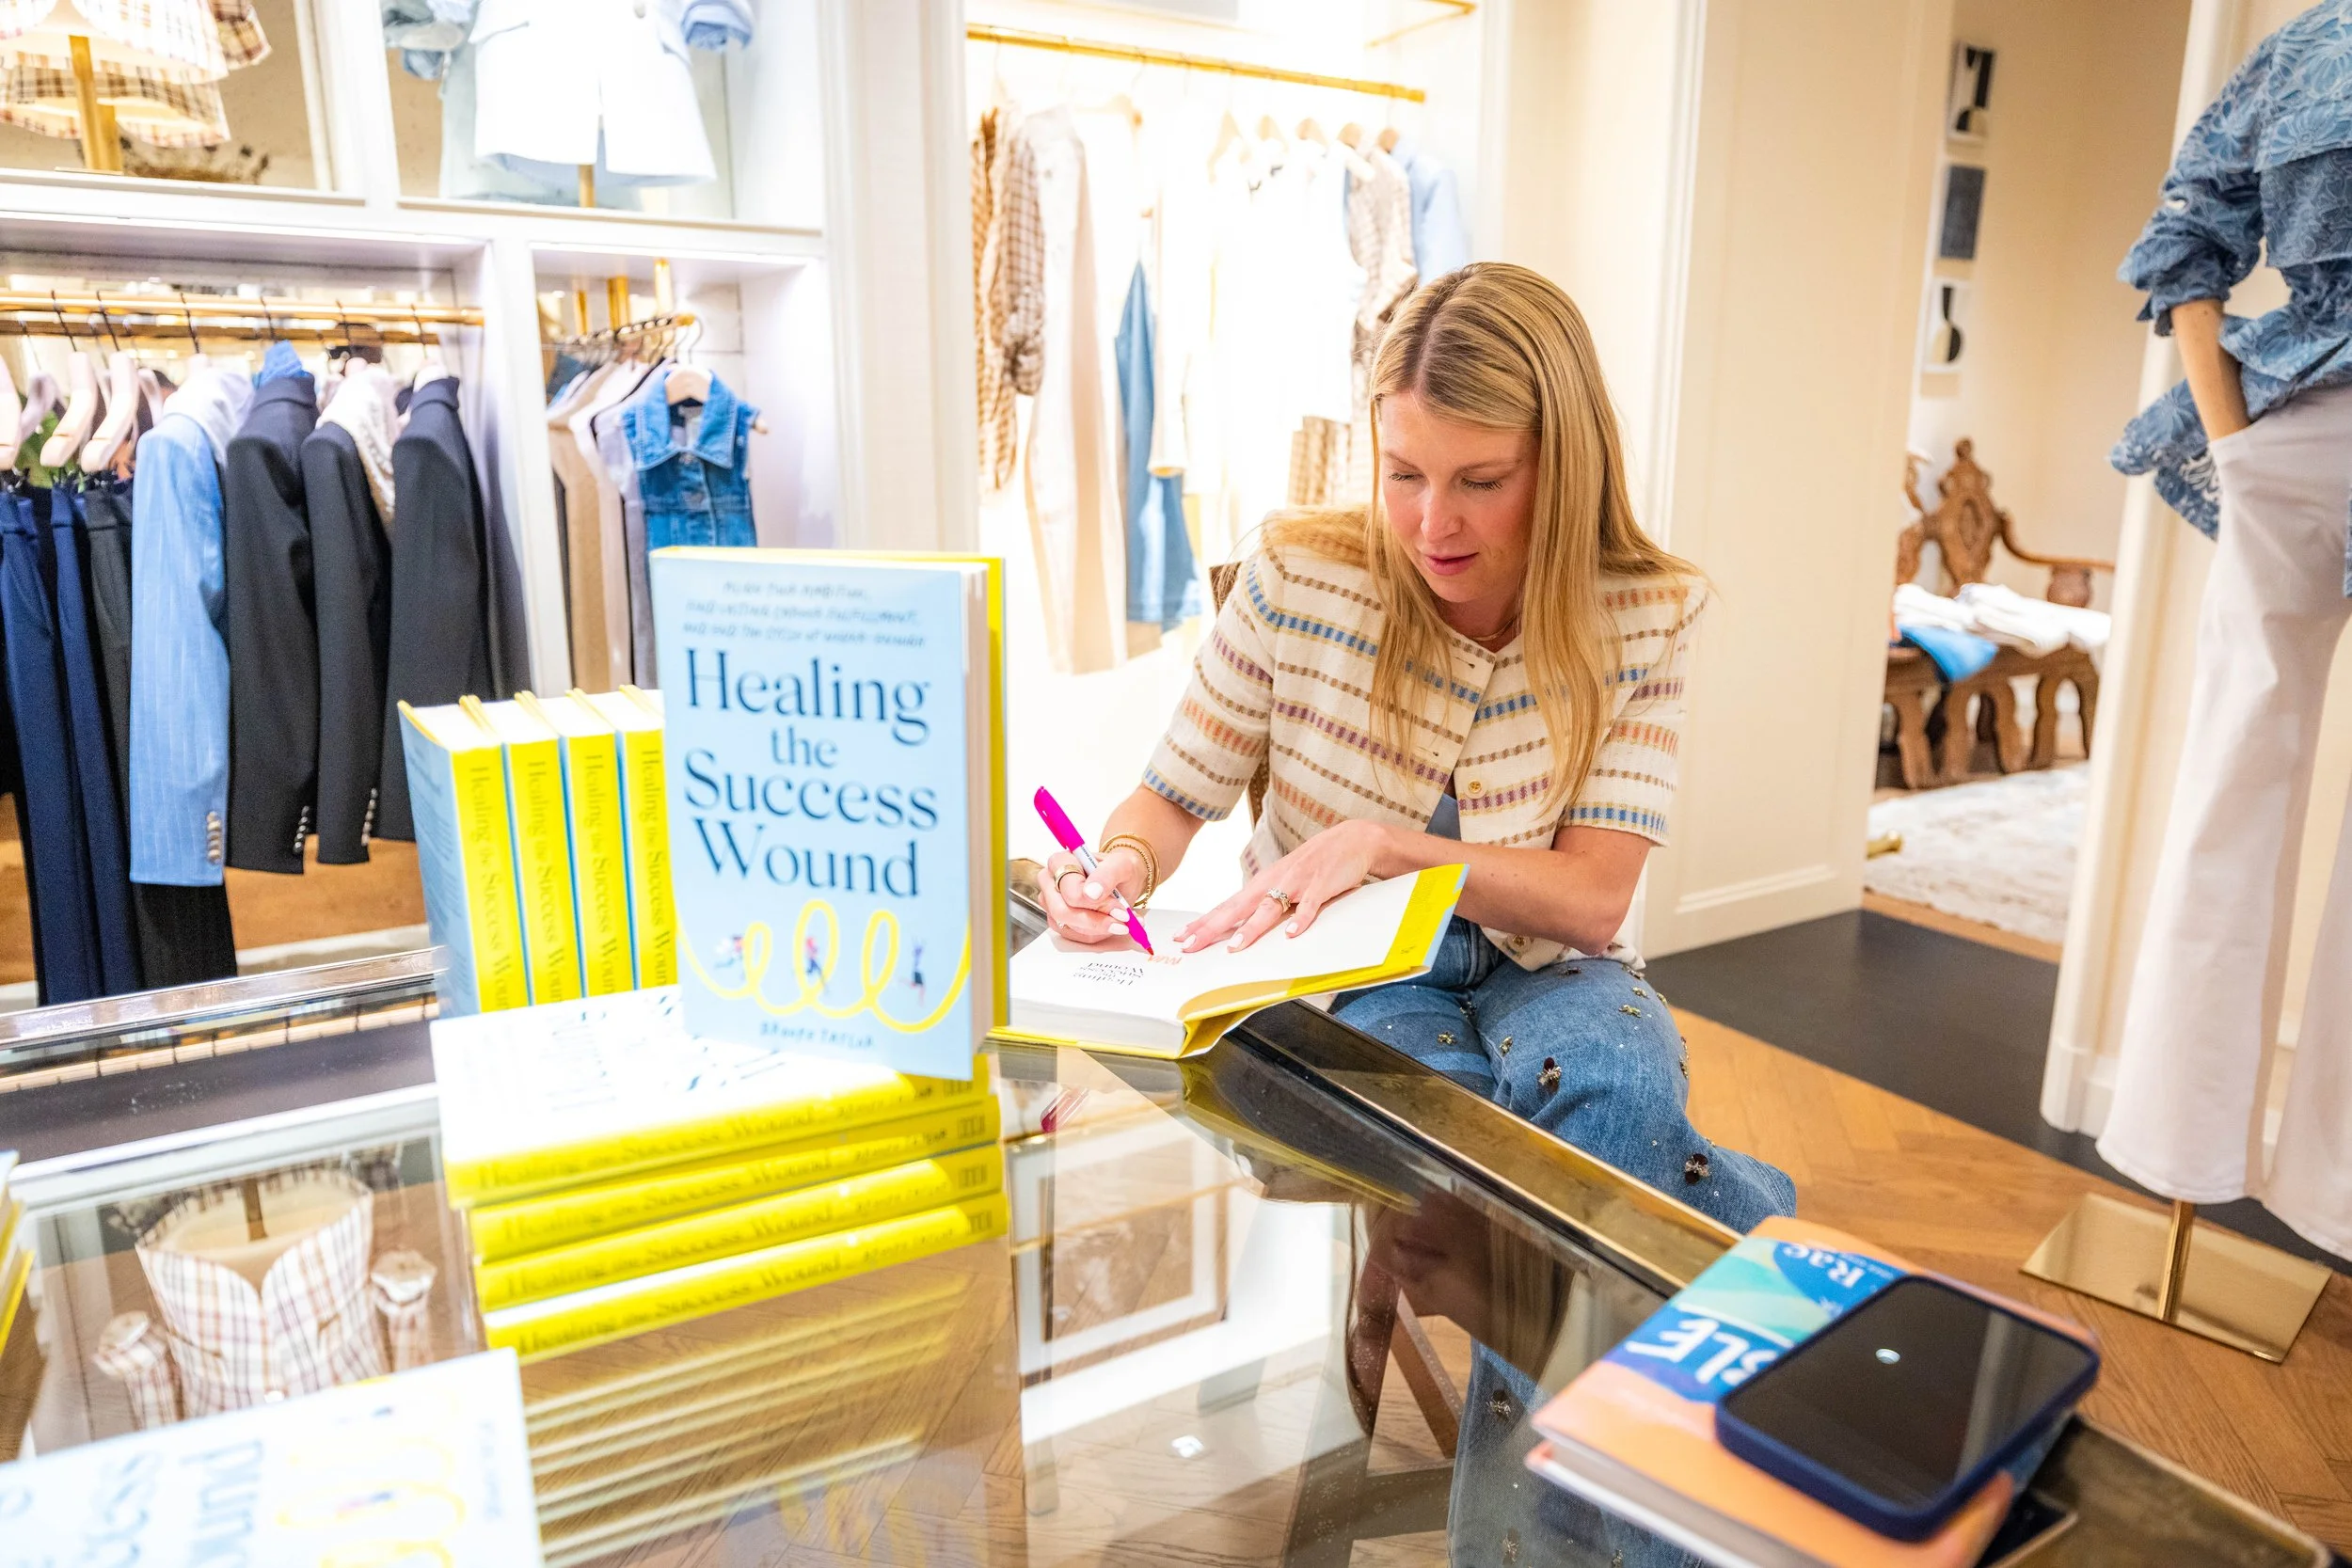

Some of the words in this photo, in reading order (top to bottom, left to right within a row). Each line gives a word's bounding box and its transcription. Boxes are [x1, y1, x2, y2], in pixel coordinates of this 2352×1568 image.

[686, 648, 931, 747] Healing
[639, 749, 660, 822] Healing
[771, 725, 838, 768] the
[684, 747, 940, 832] Success
[645, 850, 665, 927] Success
[691, 816, 921, 899] Wound
